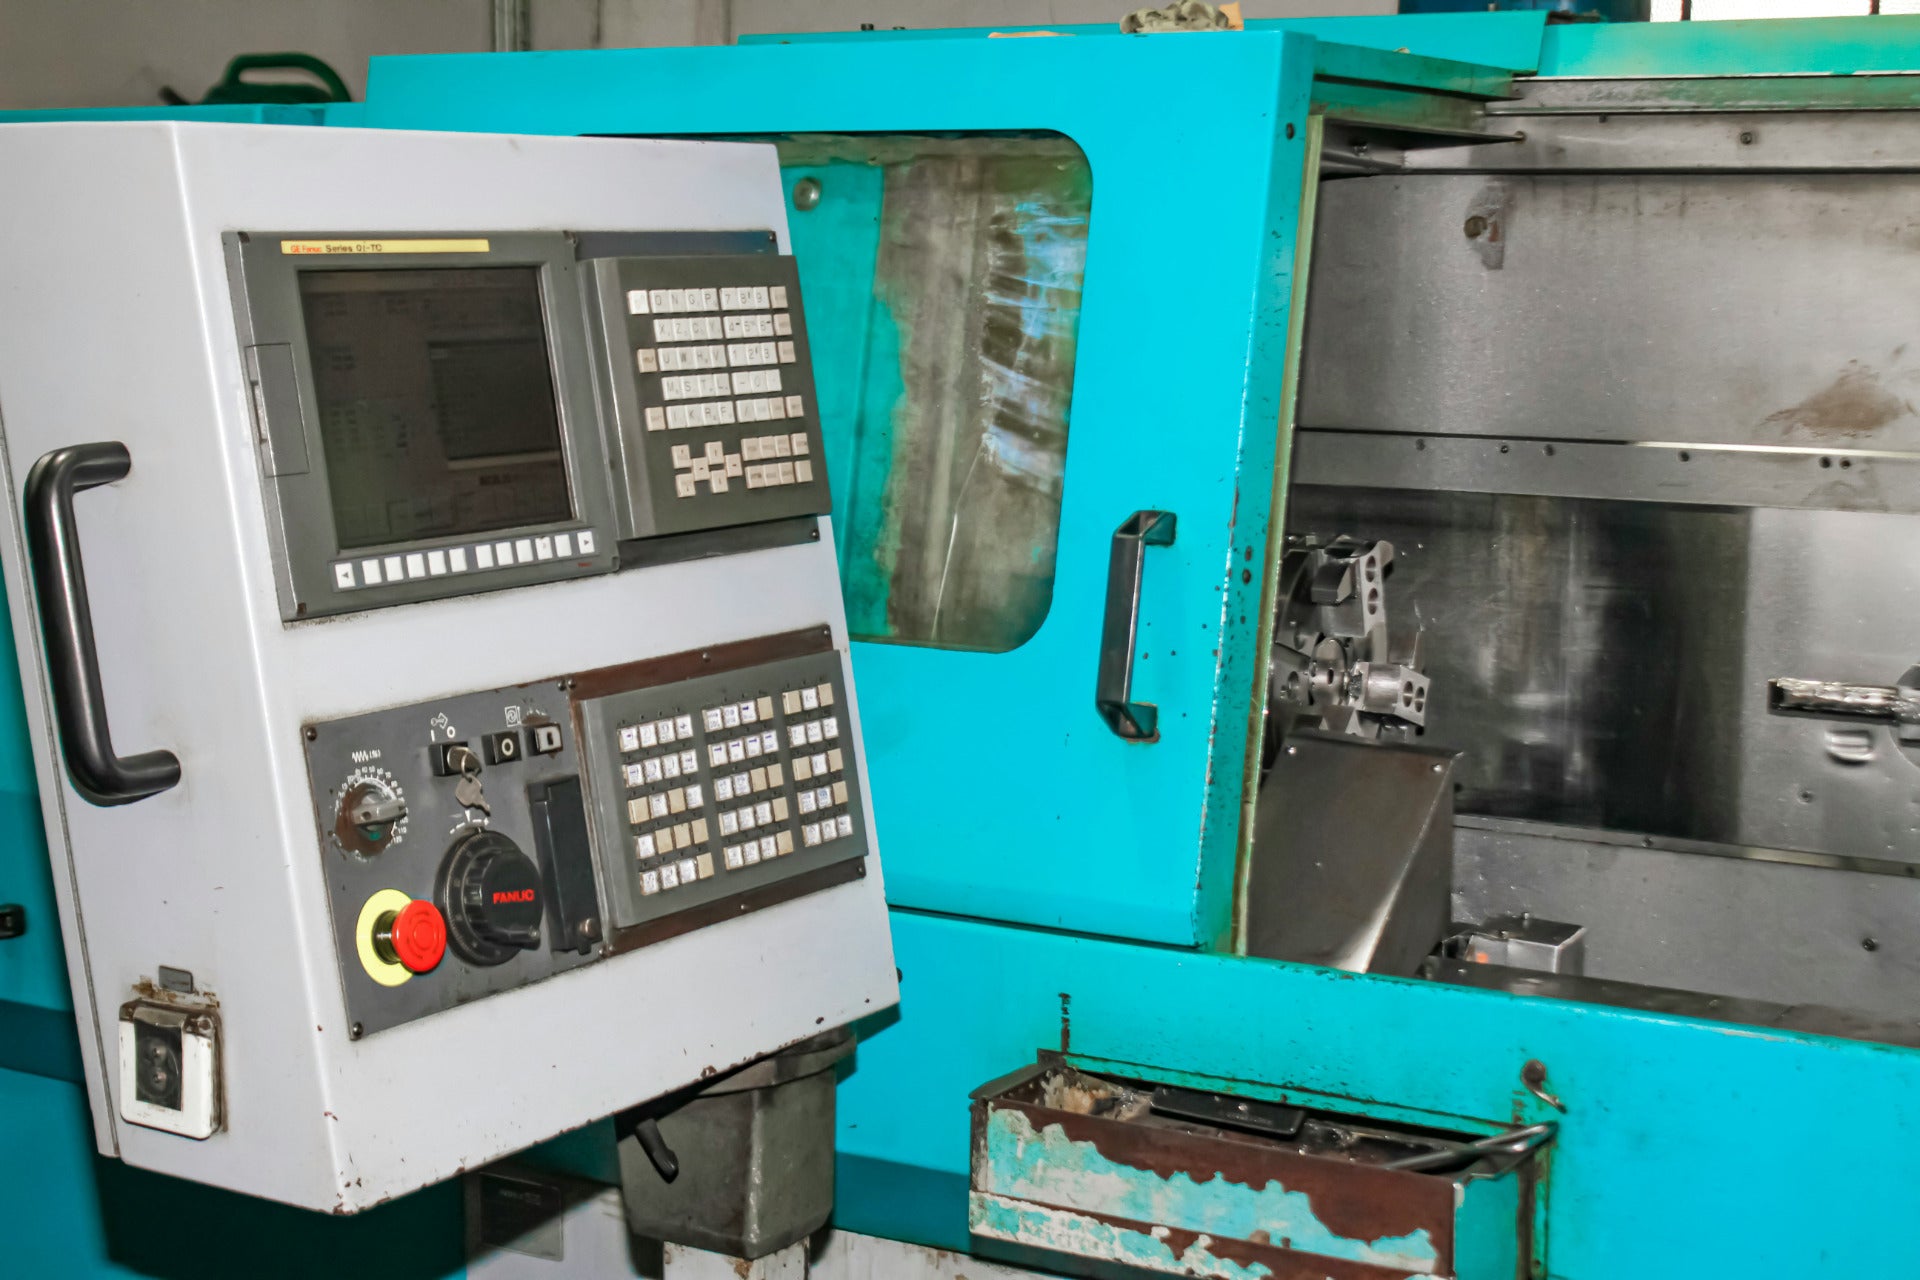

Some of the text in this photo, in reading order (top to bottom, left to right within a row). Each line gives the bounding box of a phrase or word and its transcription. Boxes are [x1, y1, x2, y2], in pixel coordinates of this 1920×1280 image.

[325, 244, 353, 252] Series
[704, 293, 711, 304] P
[725, 293, 731, 304] 7
[684, 381, 692, 392] S
[492, 888, 535, 904] FANUC
